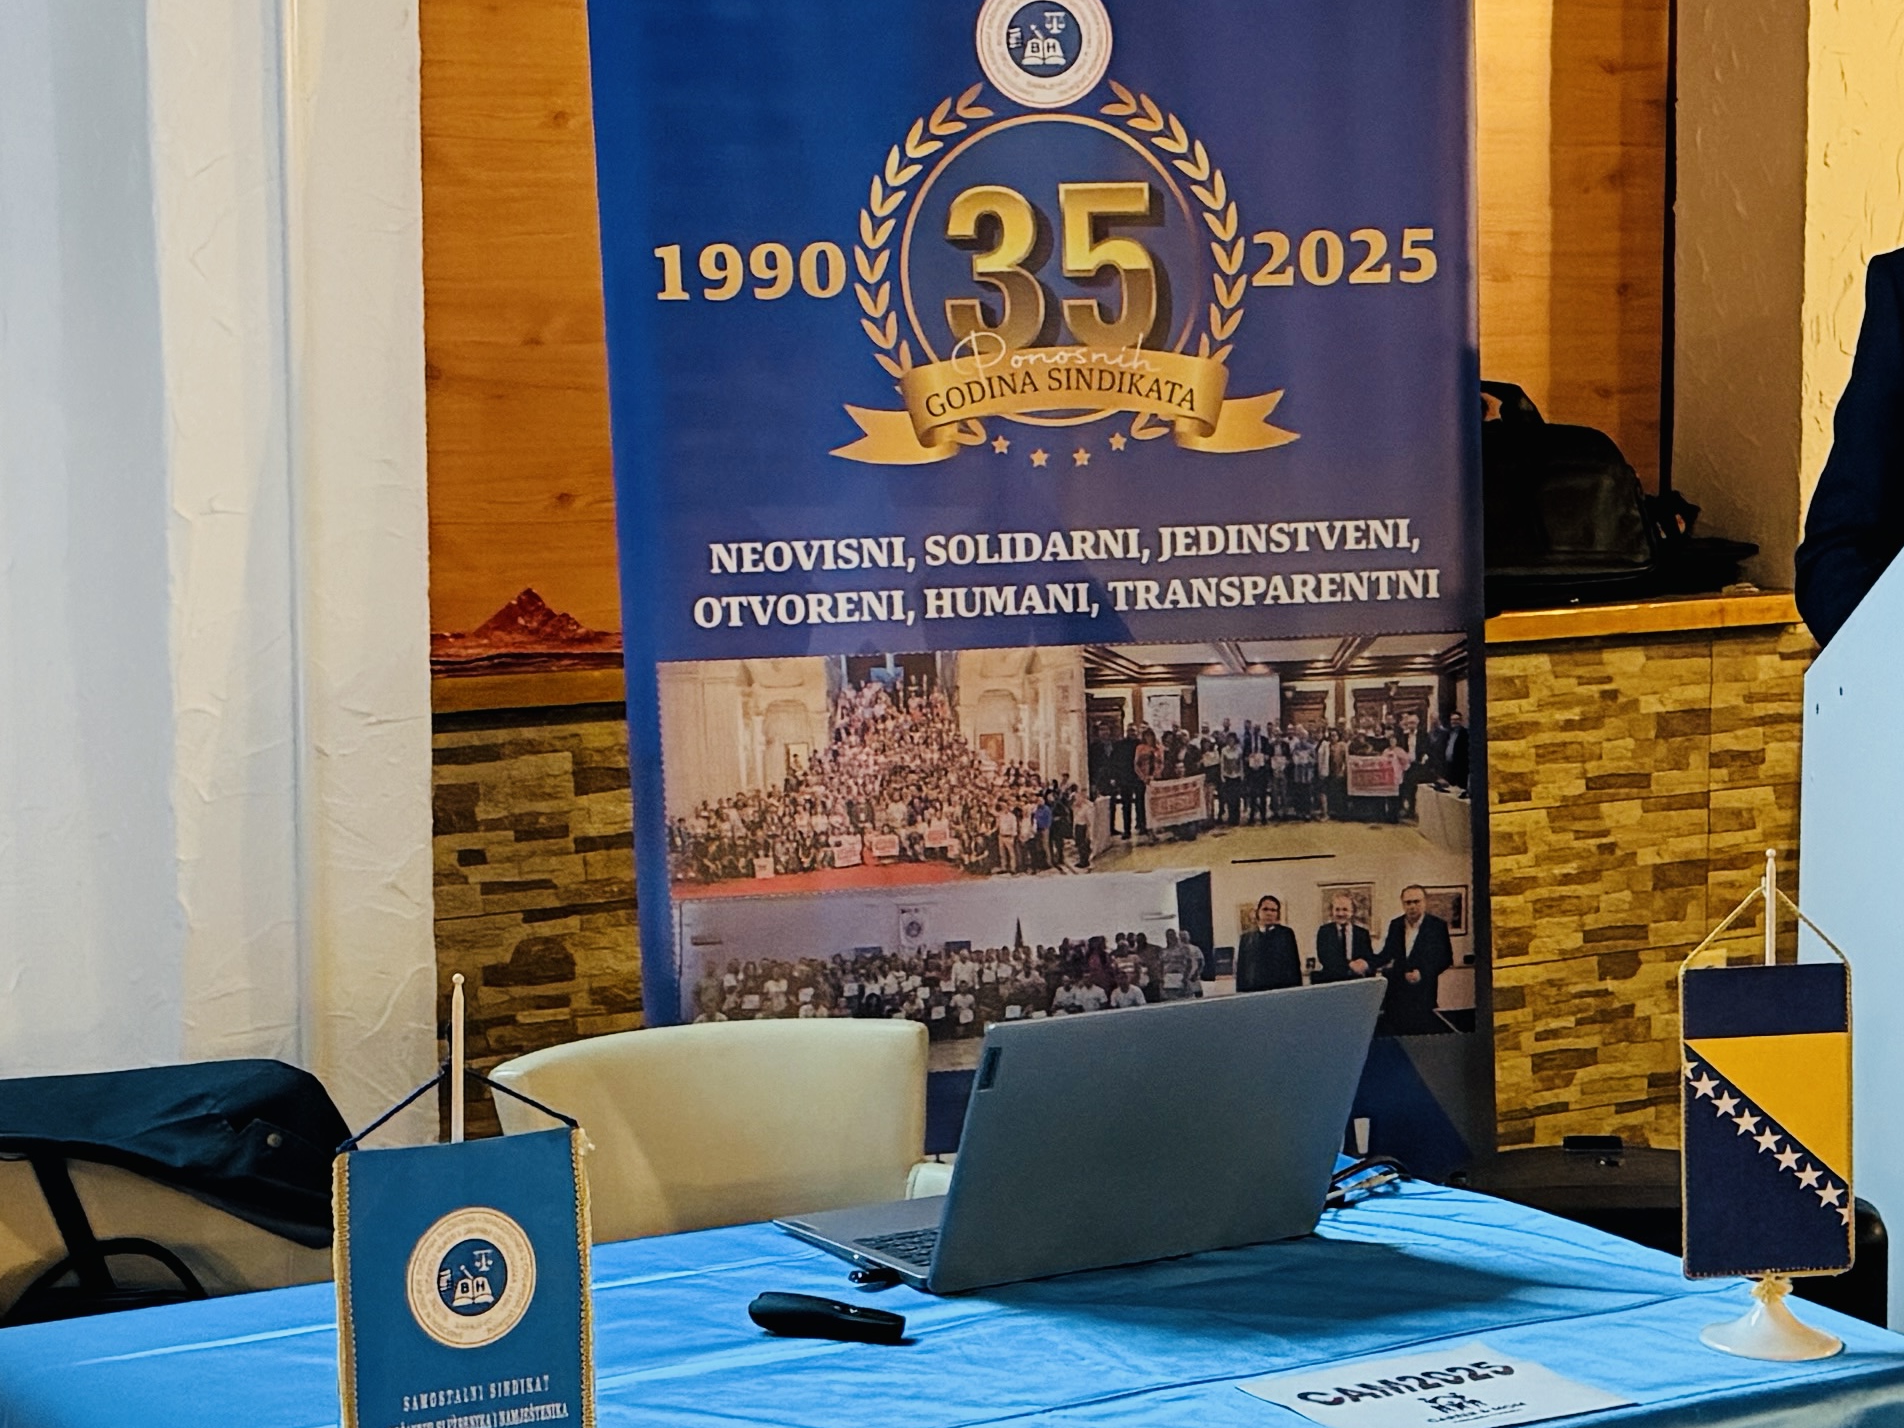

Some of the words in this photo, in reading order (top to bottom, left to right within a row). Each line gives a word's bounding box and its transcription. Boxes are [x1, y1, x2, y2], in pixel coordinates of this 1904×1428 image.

[654, 240, 848, 304] 1990
[944, 181, 1158, 351] 35
[1250, 227, 1439, 289] 2025
[952, 330, 1161, 380] Ponosnih
[924, 369, 1039, 419] GODINA
[1047, 366, 1196, 412] SINDIKATA
[709, 534, 917, 575] NEOVISNI,
[924, 527, 1150, 567] SOLIDARNI,
[1157, 517, 1421, 562] JEDINSTVENI,
[694, 590, 917, 631] OTVORENI,
[924, 582, 1101, 622] HUMANI,
[1108, 568, 1440, 614] TRANSPARENTNI
[403, 1384, 484, 1412] SAMOSTALNI
[489, 1374, 550, 1399] SINDIKAT
[1297, 1361, 1515, 1406] CAM2025
